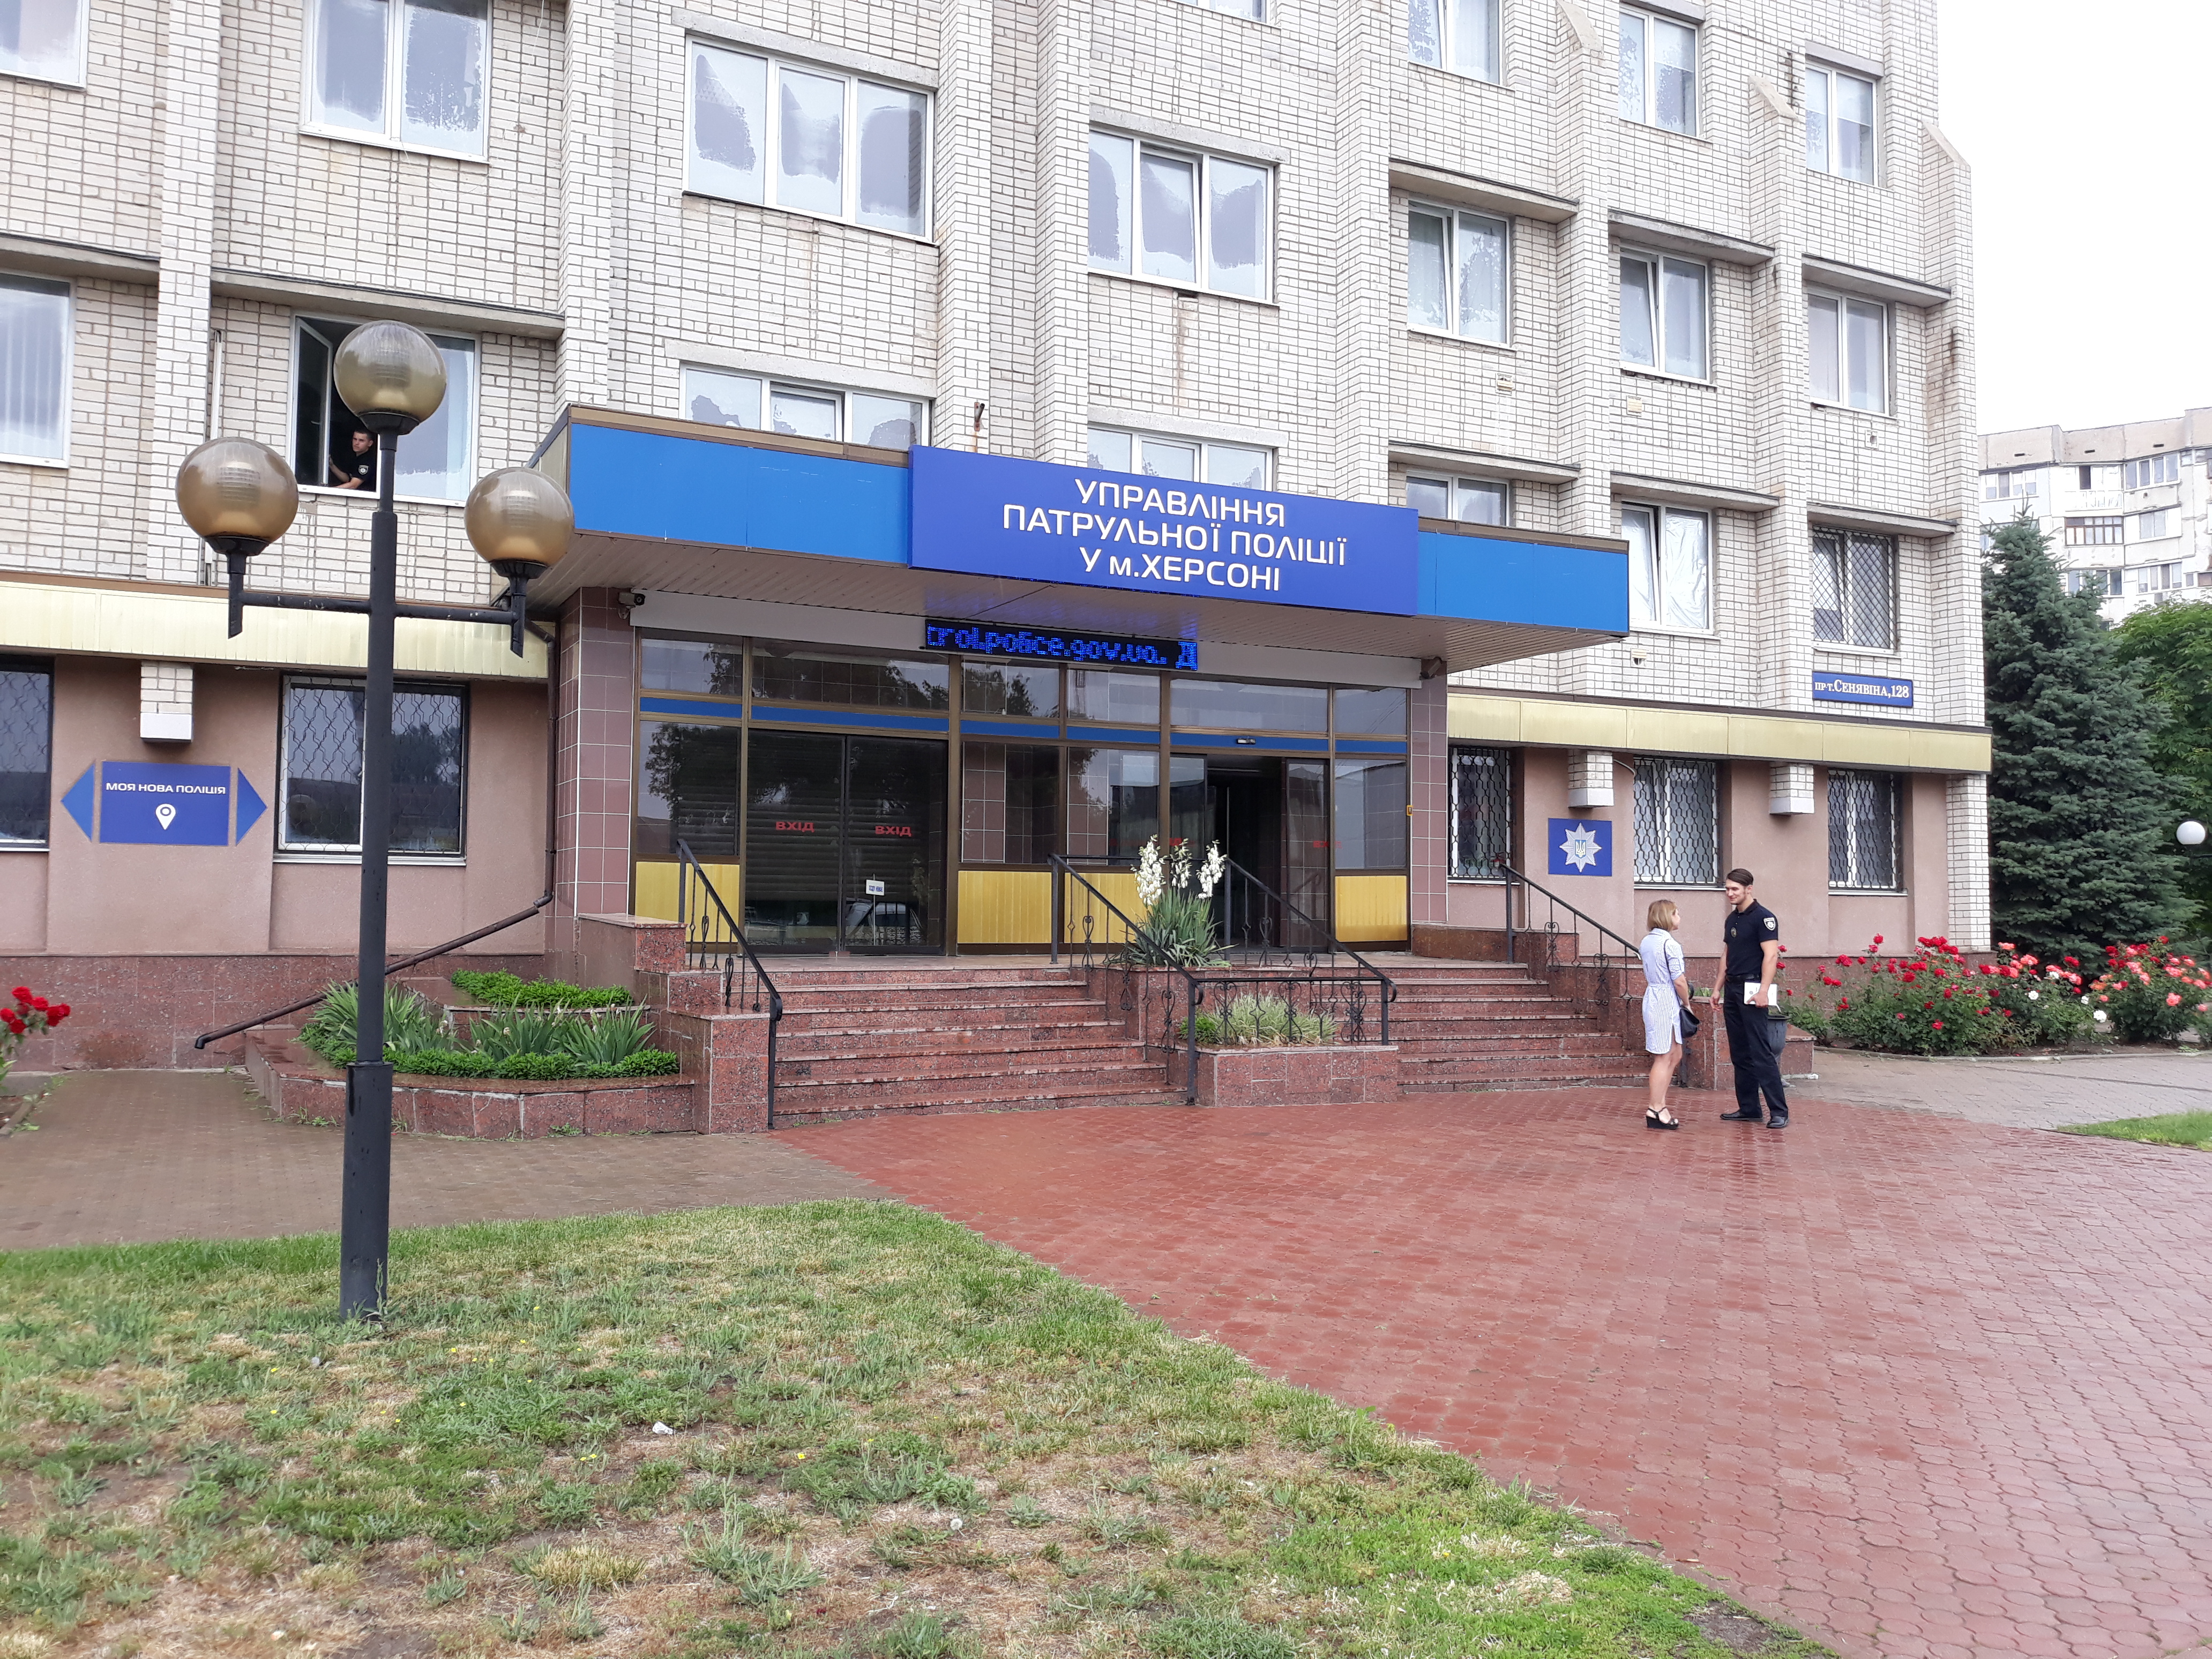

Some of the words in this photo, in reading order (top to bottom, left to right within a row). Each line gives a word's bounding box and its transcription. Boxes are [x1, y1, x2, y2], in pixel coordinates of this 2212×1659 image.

[1074, 479, 1285, 528] УПРАВЛІННЯ
[1003, 504, 1221, 552] ПАТРУЛЬНОЇ
[1230, 530, 1347, 566] ПОЛІЦІЇ
[1079, 547, 1102, 572] У
[106, 782, 136, 791] МОЯ
[138, 783, 174, 793] НОВА
[176, 785, 226, 795] ПОЛІЦІЯ
[775, 821, 814, 833] ВХІД
[875, 825, 913, 837] ВХІД
